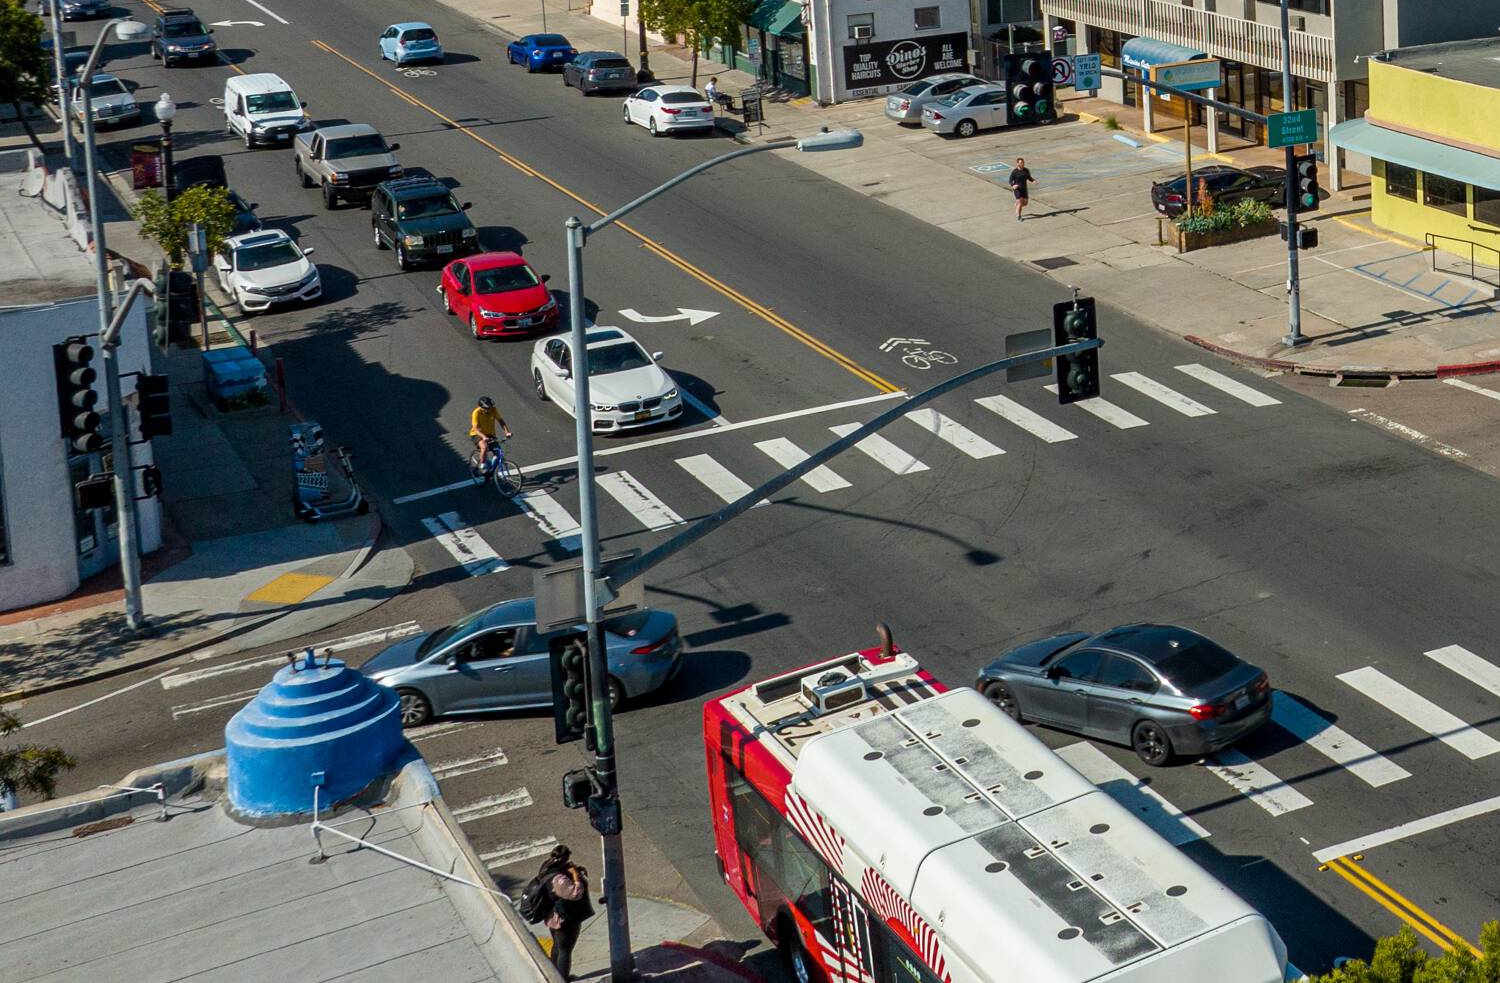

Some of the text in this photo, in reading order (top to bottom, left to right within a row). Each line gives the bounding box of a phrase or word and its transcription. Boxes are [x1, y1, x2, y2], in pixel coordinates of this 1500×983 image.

[942, 44, 953, 52] ALL
[859, 53, 871, 62] TOP
[886, 46, 927, 66] Dino's
[942, 51, 954, 60] ARE
[853, 61, 878, 72] QUALITY
[933, 58, 963, 70] WELCOME
[851, 69, 881, 80] HAIRCUTS
[1281, 114, 1301, 124] 32nd
